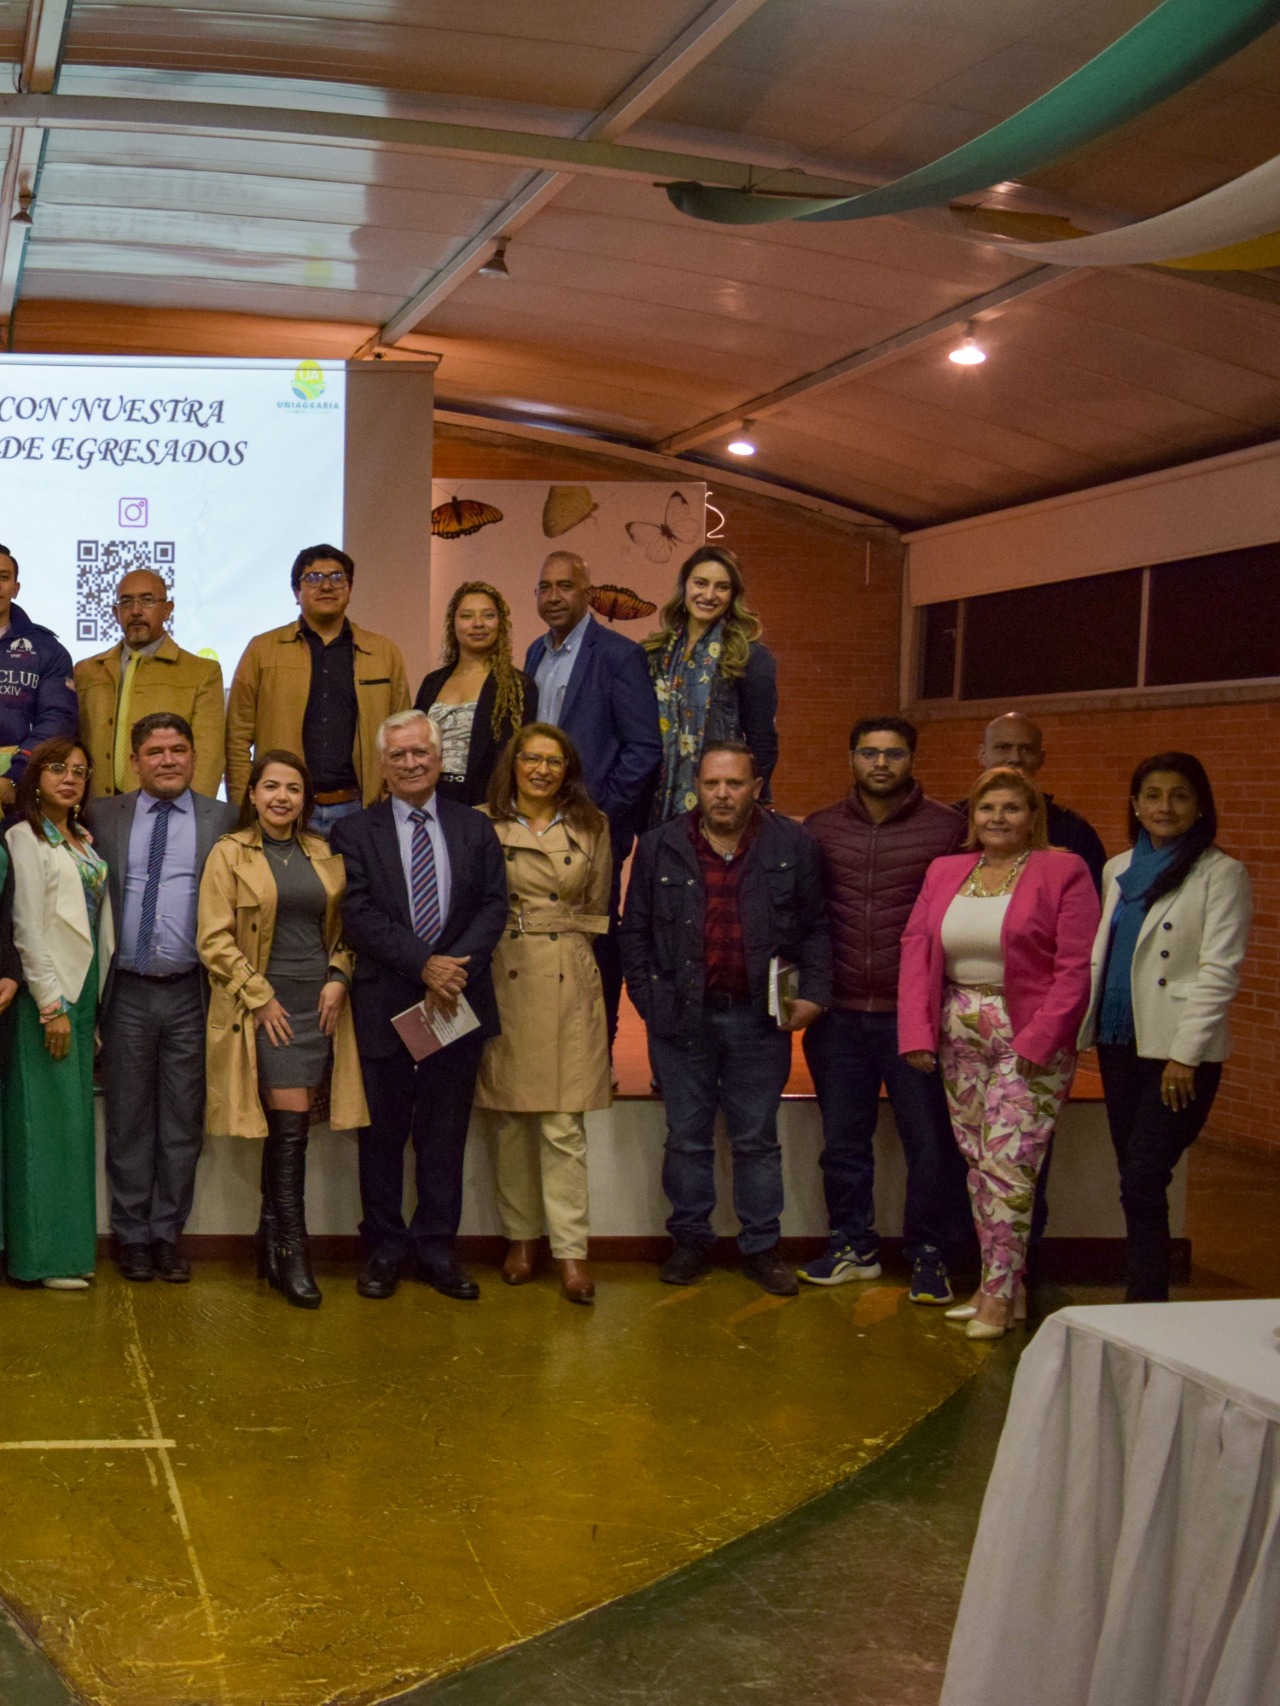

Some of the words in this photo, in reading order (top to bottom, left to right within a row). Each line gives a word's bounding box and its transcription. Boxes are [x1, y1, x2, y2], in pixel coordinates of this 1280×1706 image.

[299, 368, 320, 381] UA
[69, 395, 225, 428] NUESTRA
[276, 401, 339, 410] UNIAGRARIA
[52, 437, 248, 470] EGRESADOS
